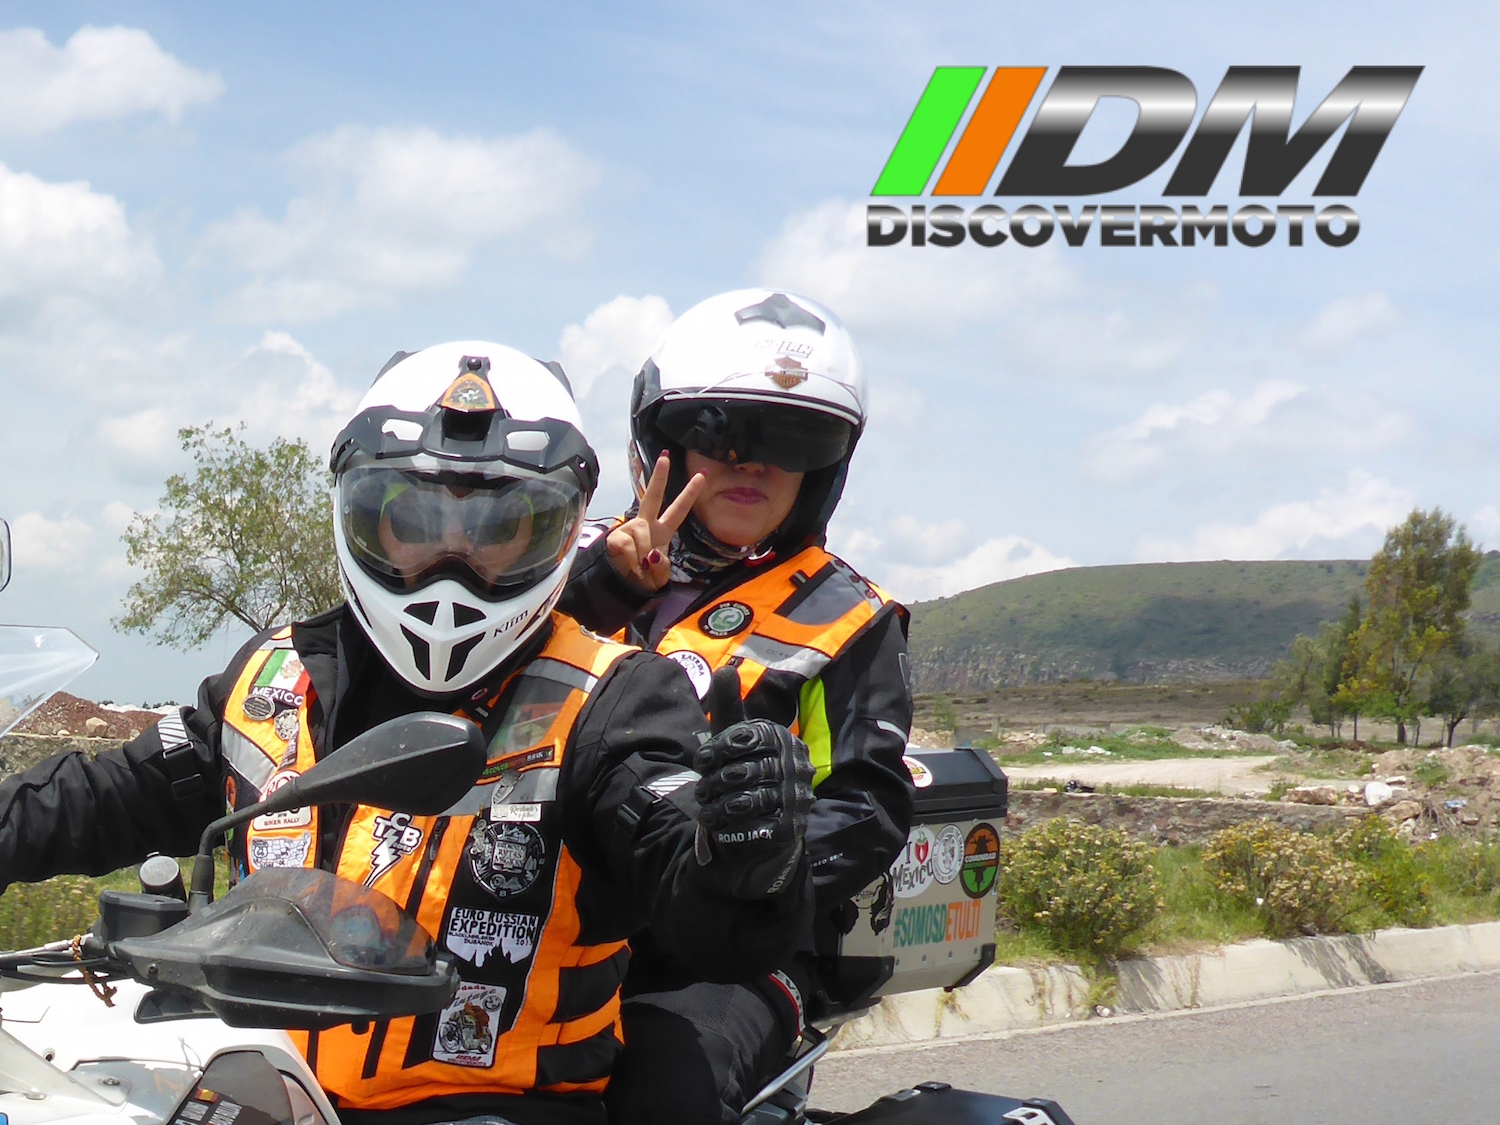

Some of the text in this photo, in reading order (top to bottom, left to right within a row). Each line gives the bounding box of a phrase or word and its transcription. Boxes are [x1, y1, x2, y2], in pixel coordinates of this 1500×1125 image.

[681, 654, 705, 677] KATRINA
[374, 812, 421, 848] TCB
[718, 828, 774, 843] ROAD JACK
[455, 908, 536, 927] EURO RUSSIAN
[450, 918, 536, 940] EXPEDITION
